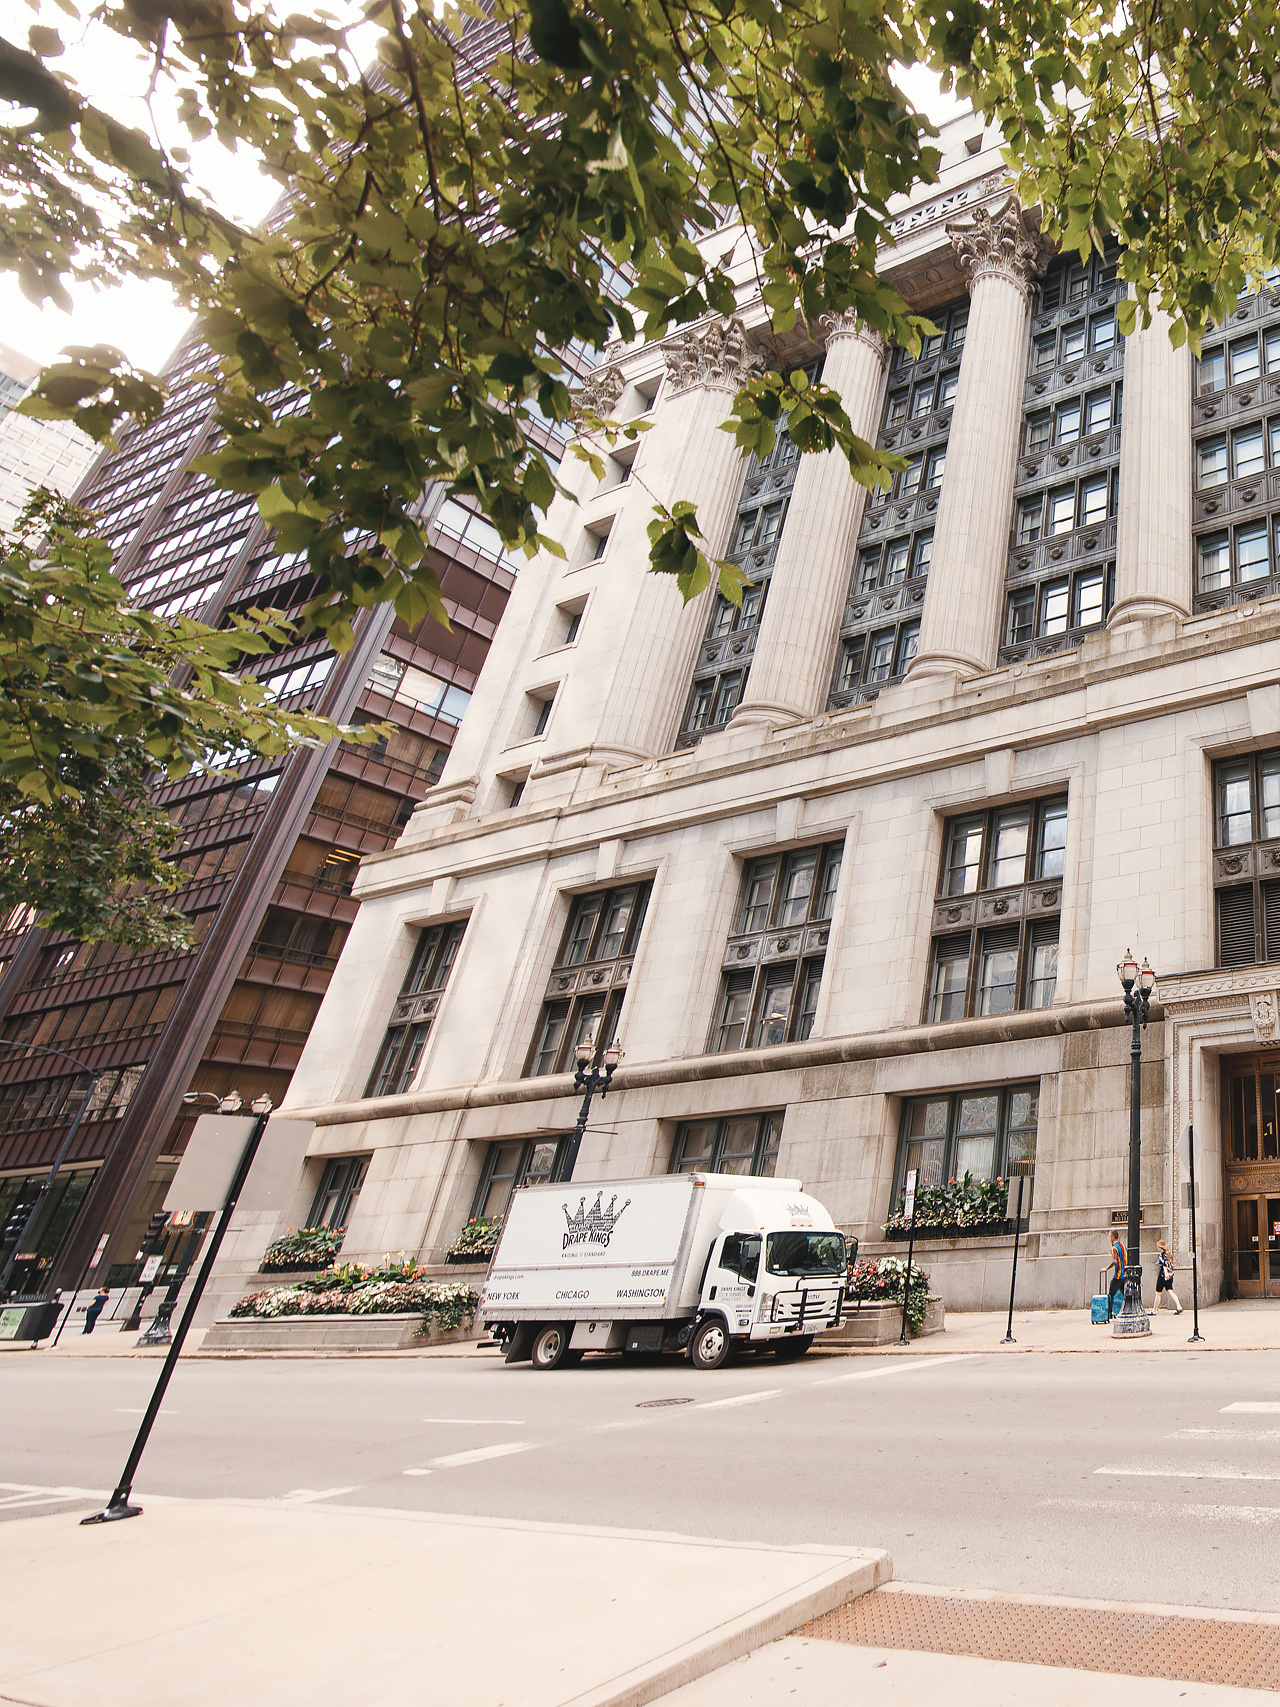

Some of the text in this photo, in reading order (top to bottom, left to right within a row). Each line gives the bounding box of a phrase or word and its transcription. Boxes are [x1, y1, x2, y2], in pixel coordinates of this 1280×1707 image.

[562, 1229, 614, 1250] DRAPE KINGS
[487, 1291, 520, 1300] NEW YORK
[555, 1290, 590, 1300] CHICAGO
[616, 1288, 666, 1298] WASHINGTON
